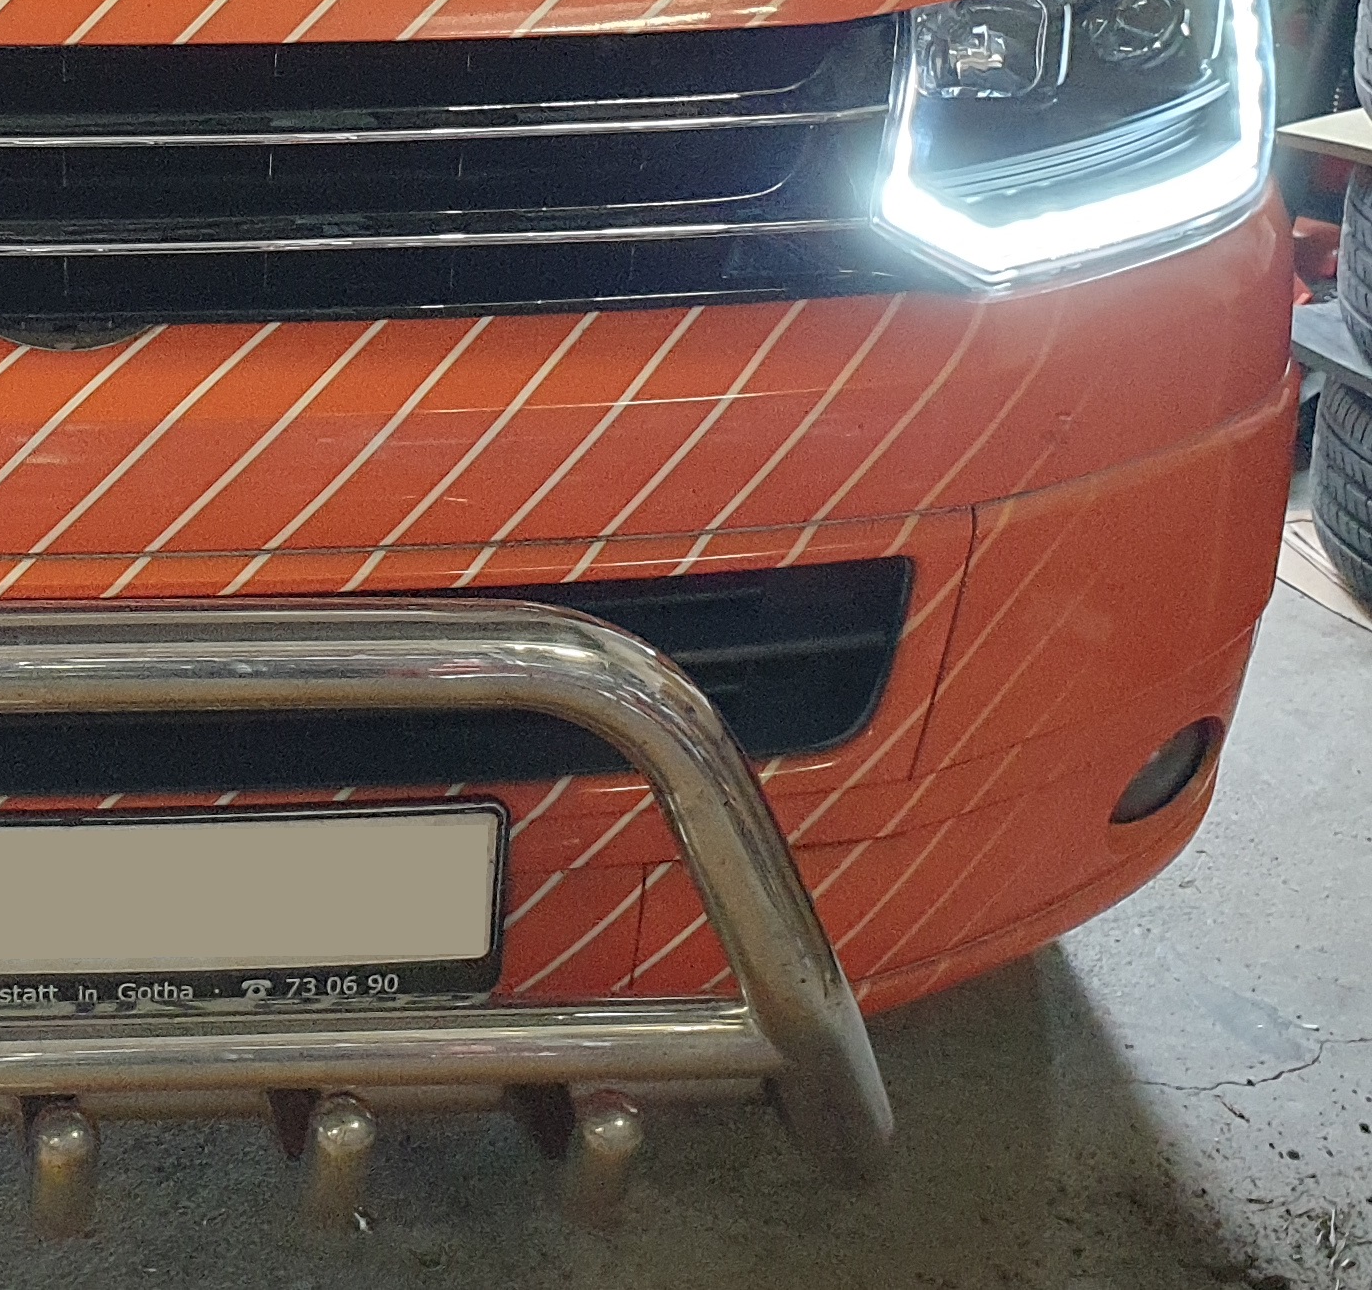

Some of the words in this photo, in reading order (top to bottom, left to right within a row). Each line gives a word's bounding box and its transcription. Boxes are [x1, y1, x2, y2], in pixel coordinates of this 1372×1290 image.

[78, 984, 98, 1004] in
[117, 981, 194, 1002] Gotha
[285, 976, 316, 998] 73
[326, 975, 358, 996] 06
[367, 973, 400, 994] 90
